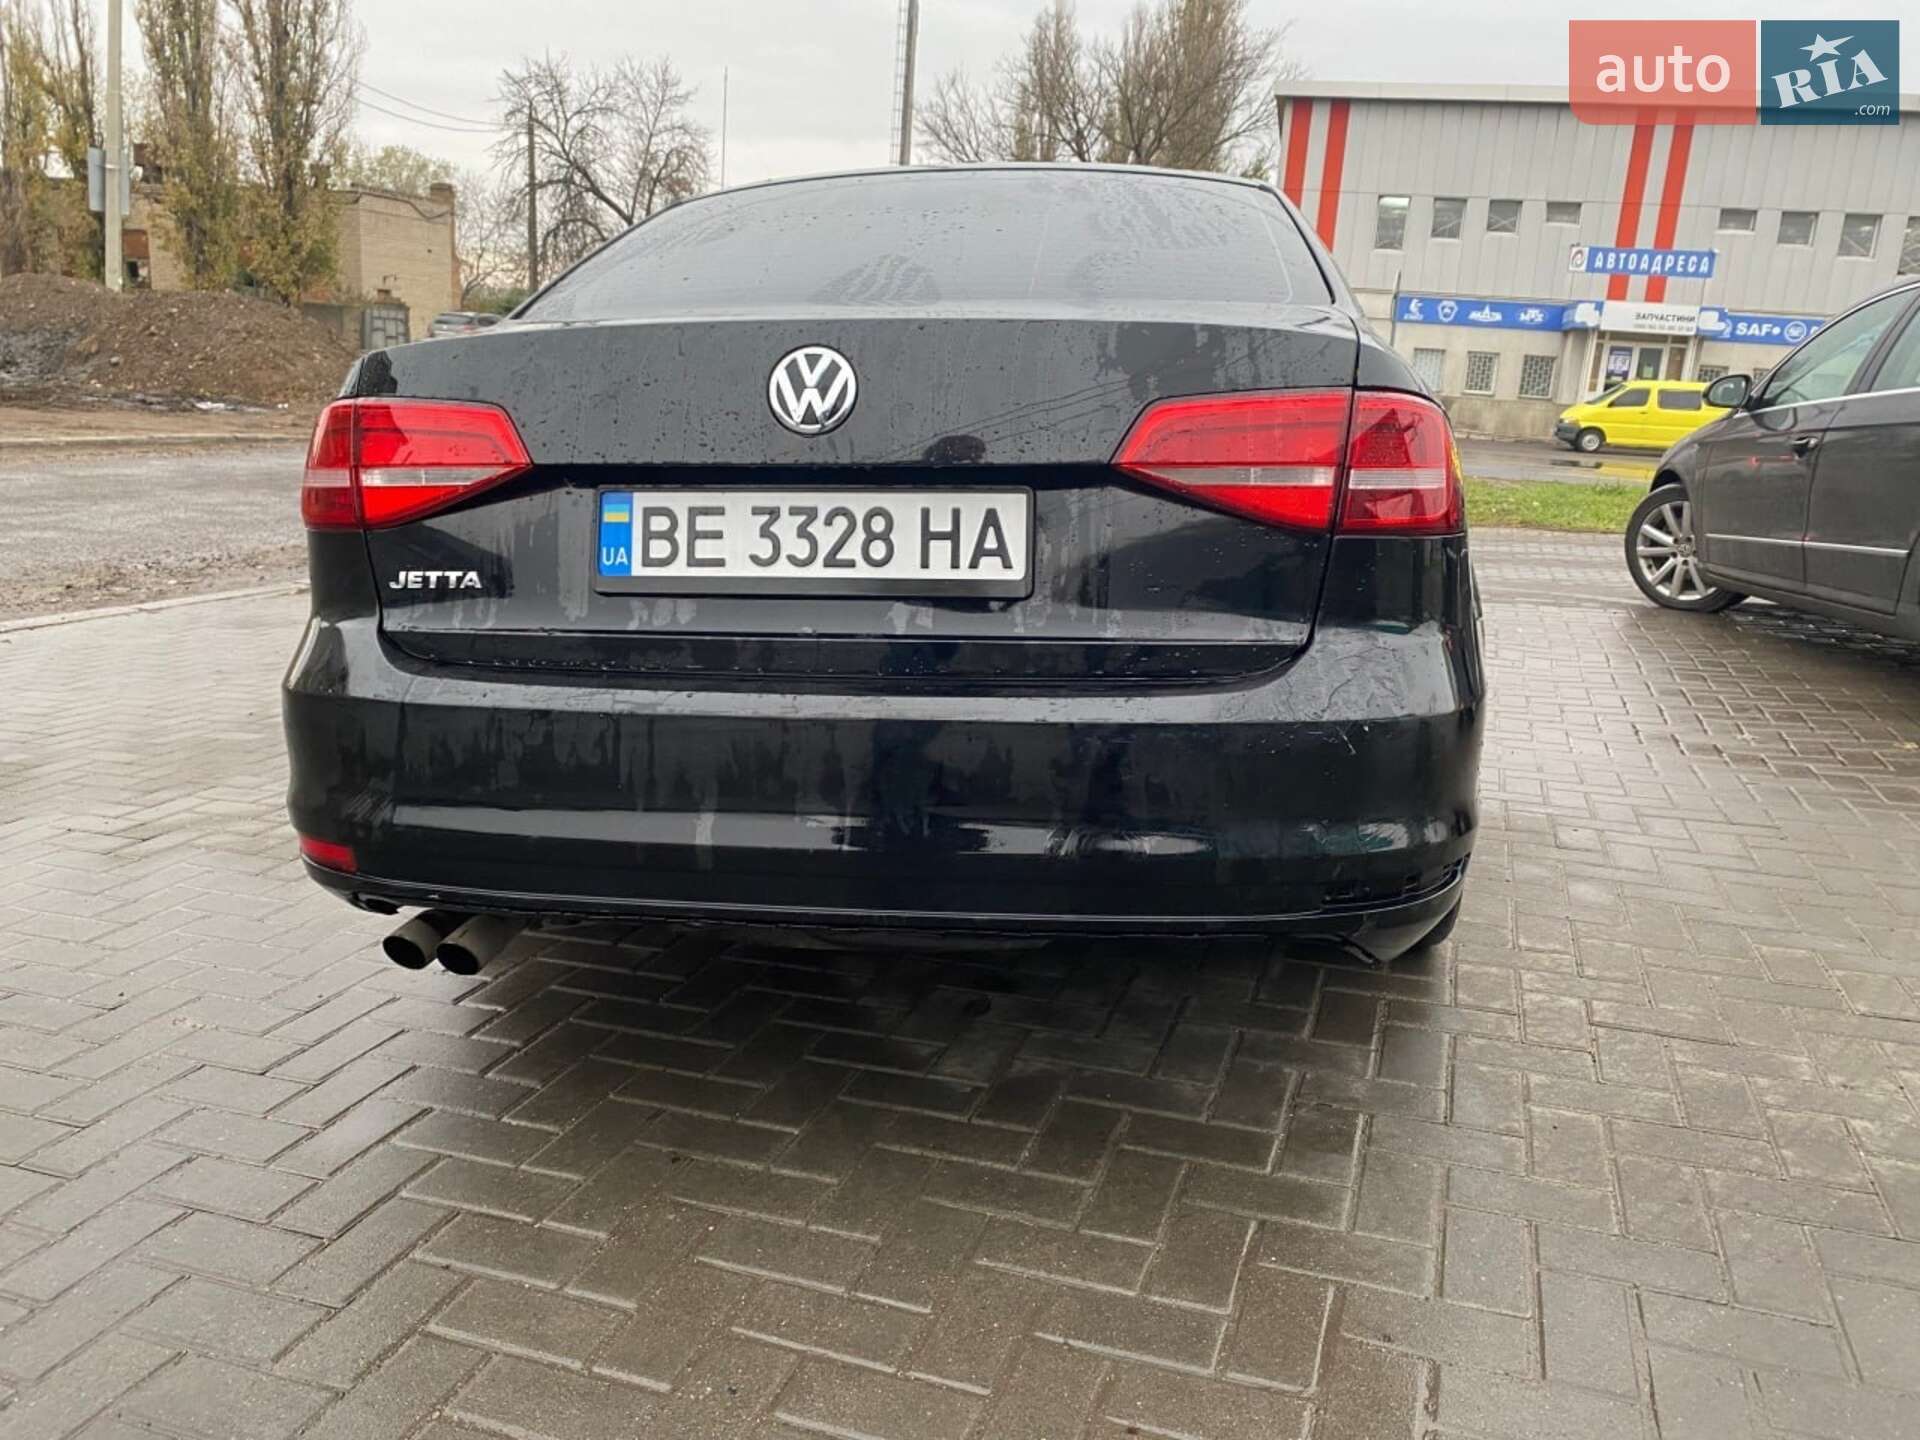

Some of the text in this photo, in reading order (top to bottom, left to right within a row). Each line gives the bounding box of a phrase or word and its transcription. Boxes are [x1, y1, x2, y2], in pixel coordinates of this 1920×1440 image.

[1594, 251, 1710, 274] АВТОАДРЕСА
[641, 506, 1014, 570] BE 3328 HA
[602, 545, 629, 566] UA
[389, 570, 482, 590] JETTA
